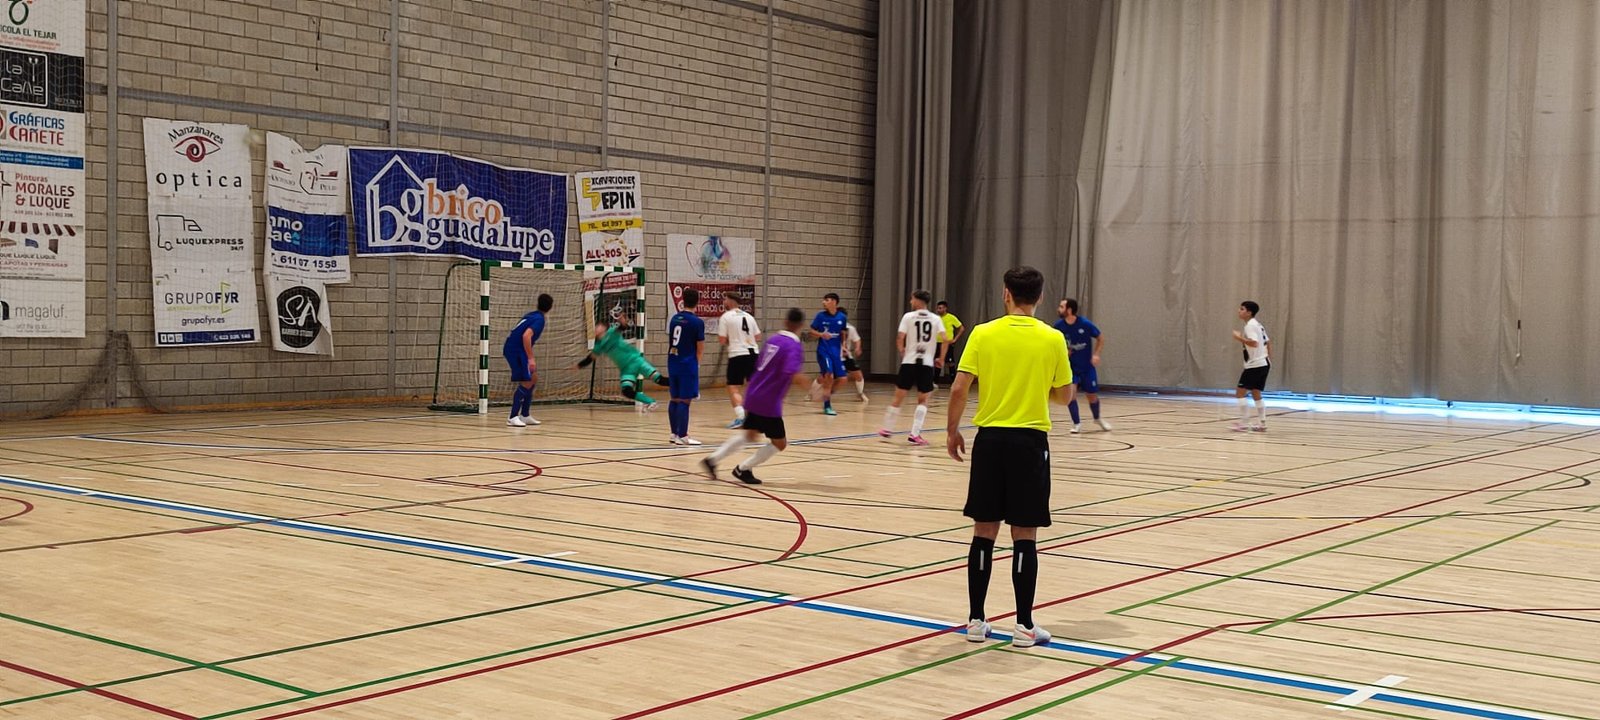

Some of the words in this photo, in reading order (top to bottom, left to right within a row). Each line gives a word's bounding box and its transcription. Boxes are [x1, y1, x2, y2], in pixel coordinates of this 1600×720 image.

[23, 28, 31, 37] EL
[33, 29, 57, 39] TEJAR
[9, 111, 65, 130] GRÁFICAS
[9, 125, 65, 146] CAÑETE
[168, 126, 224, 144] Manzanares
[15, 172, 48, 182] Pinturas
[156, 169, 242, 192] optica
[15, 182, 75, 197] MORALES
[15, 194, 25, 206] &
[29, 196, 71, 210] LUQUE
[426, 180, 502, 226] brico
[176, 238, 244, 246] LUQUEXPRESS
[426, 216, 555, 258] guadalupe
[742, 316, 750, 336] 4
[915, 320, 932, 343] 19
[673, 325, 682, 347] 9
